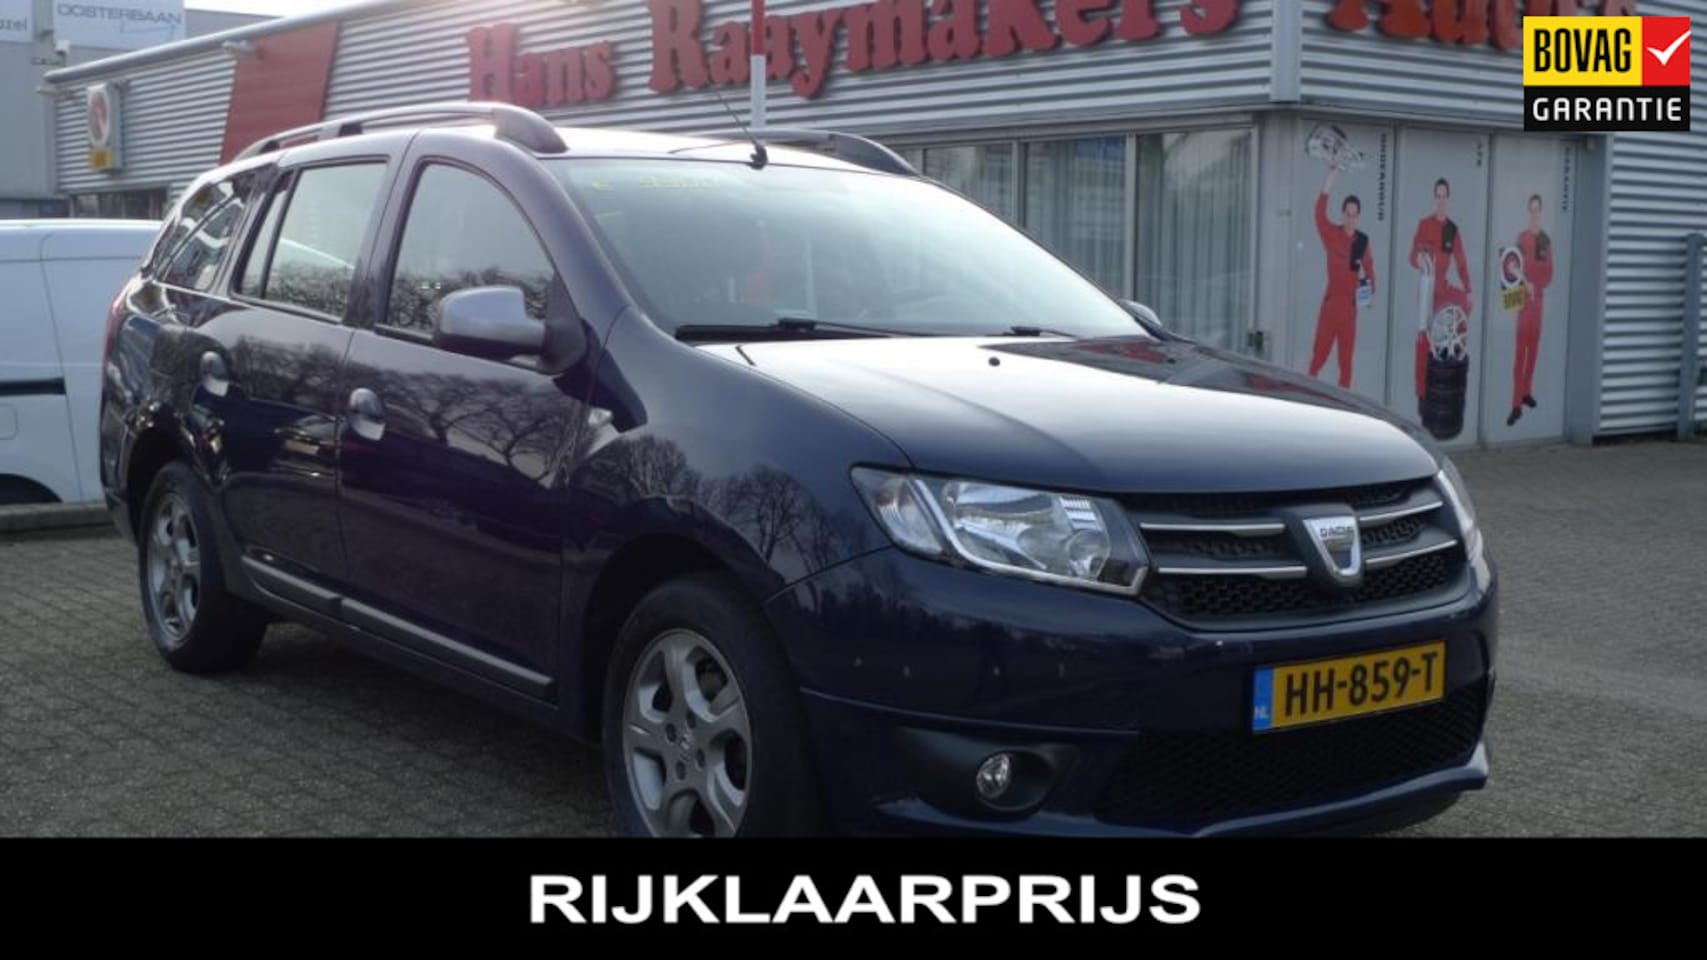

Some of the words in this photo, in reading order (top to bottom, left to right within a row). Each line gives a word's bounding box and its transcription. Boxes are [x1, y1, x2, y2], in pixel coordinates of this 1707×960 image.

[57, 4, 182, 25] OOSTERBAAN
[467, 22, 617, 107] Hans
[1285, 651, 1438, 717] HH-859-T
